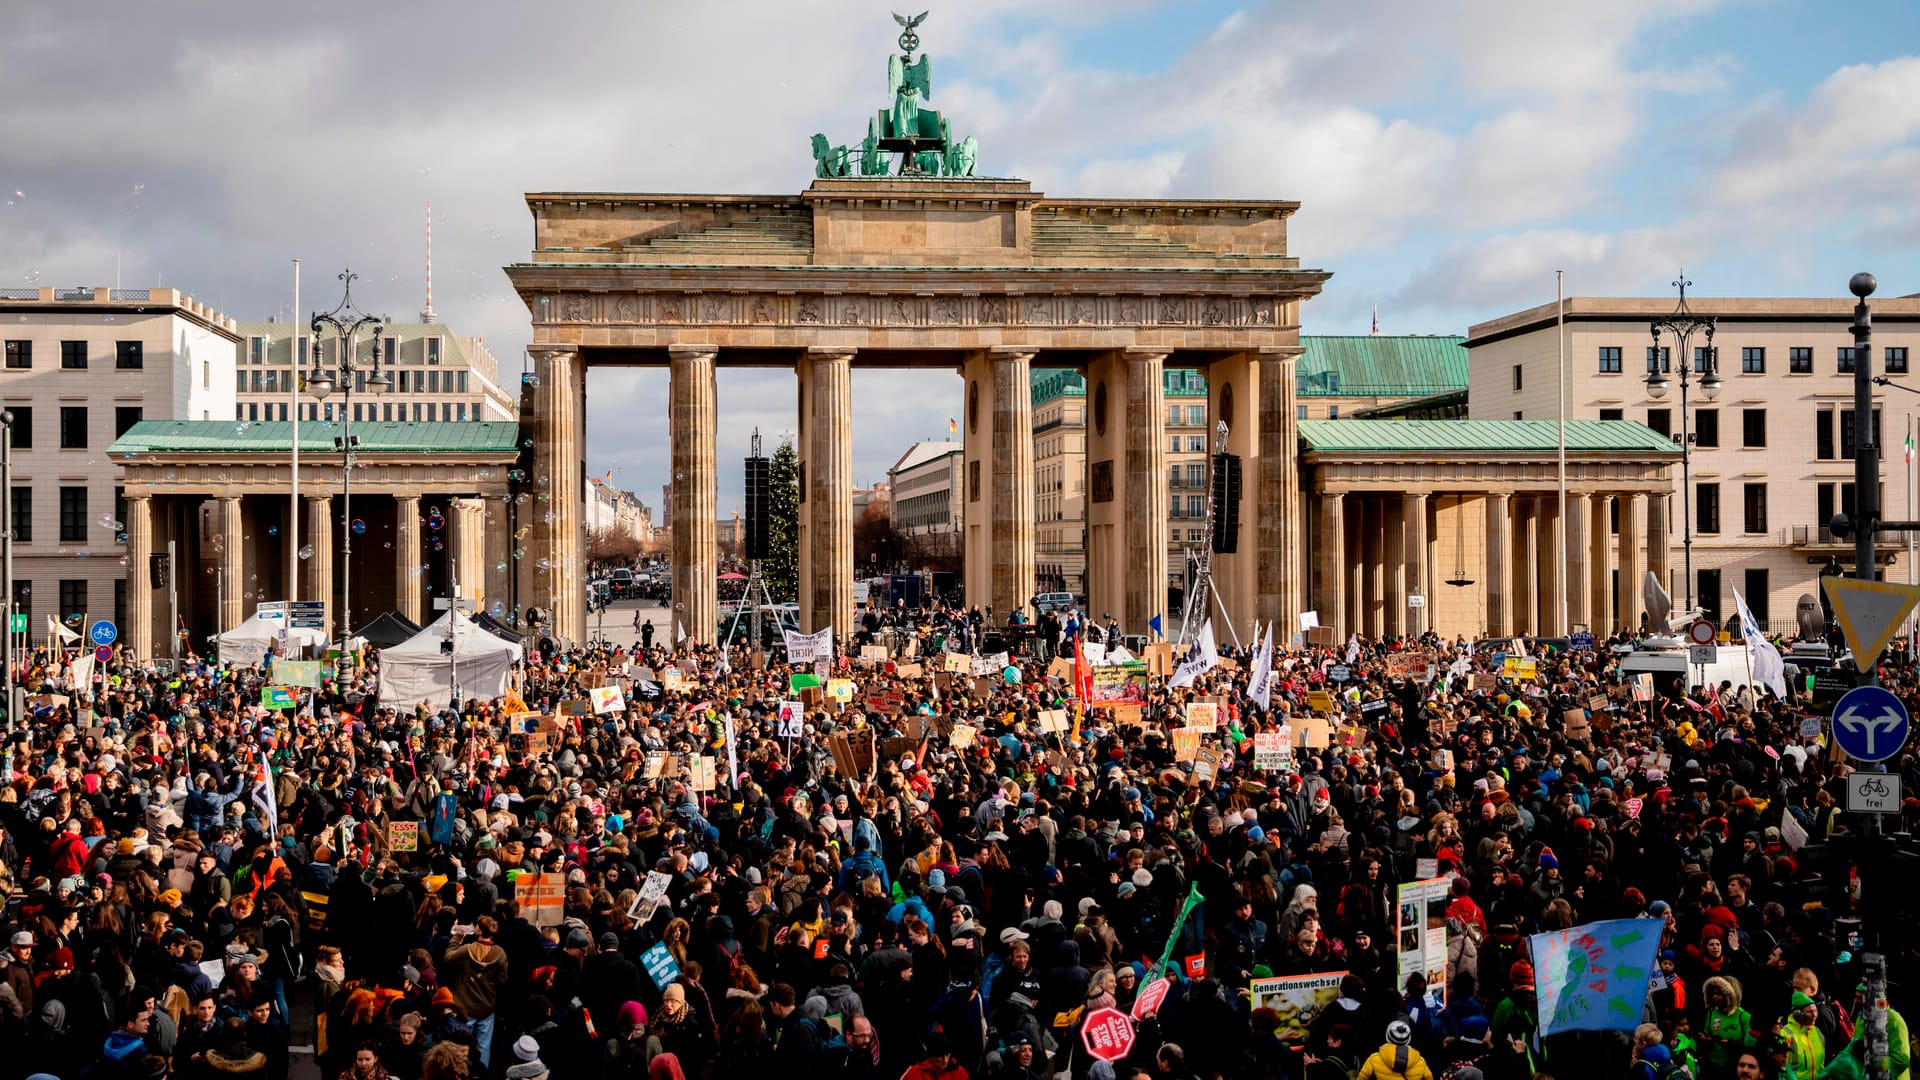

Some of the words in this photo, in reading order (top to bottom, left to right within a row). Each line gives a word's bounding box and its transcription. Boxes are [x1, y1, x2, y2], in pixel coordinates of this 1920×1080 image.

[1866, 799, 1883, 808] frei
[1253, 977, 1340, 993] Generationswechsel
[1097, 1023, 1113, 1047] STOP
[1114, 1017, 1129, 1041] STOP
